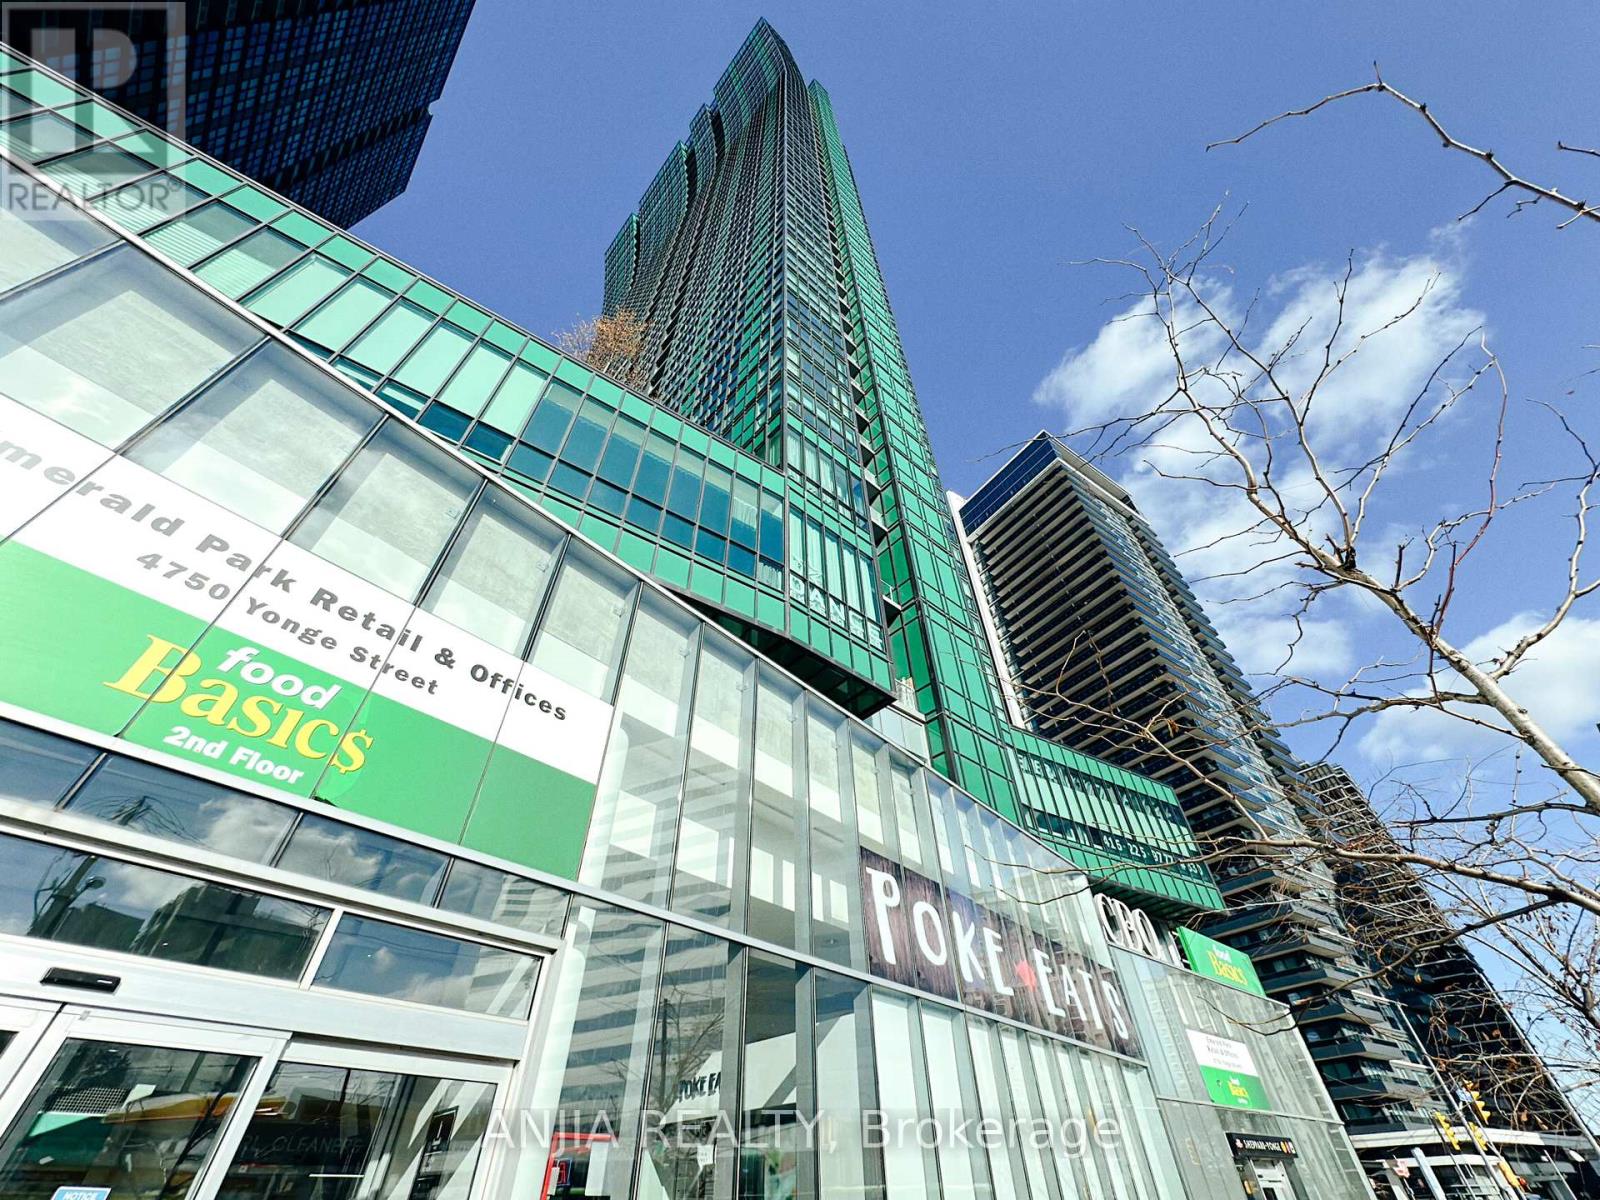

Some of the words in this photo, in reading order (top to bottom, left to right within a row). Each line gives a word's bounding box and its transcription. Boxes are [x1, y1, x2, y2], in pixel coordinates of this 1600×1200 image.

[0, 439, 186, 537] merald
[195, 533, 297, 594] Park
[309, 587, 424, 653] Retail
[434, 647, 456, 670] &
[470, 663, 568, 721] Offices
[136, 553, 231, 601] 4750
[246, 597, 338, 651] Yonge
[349, 646, 439, 696] Street
[216, 646, 343, 711] food
[163, 725, 229, 760] 2nd
[229, 746, 305, 785] Floor
[866, 866, 1015, 997] POKE
[1031, 947, 1130, 1041] EATS
